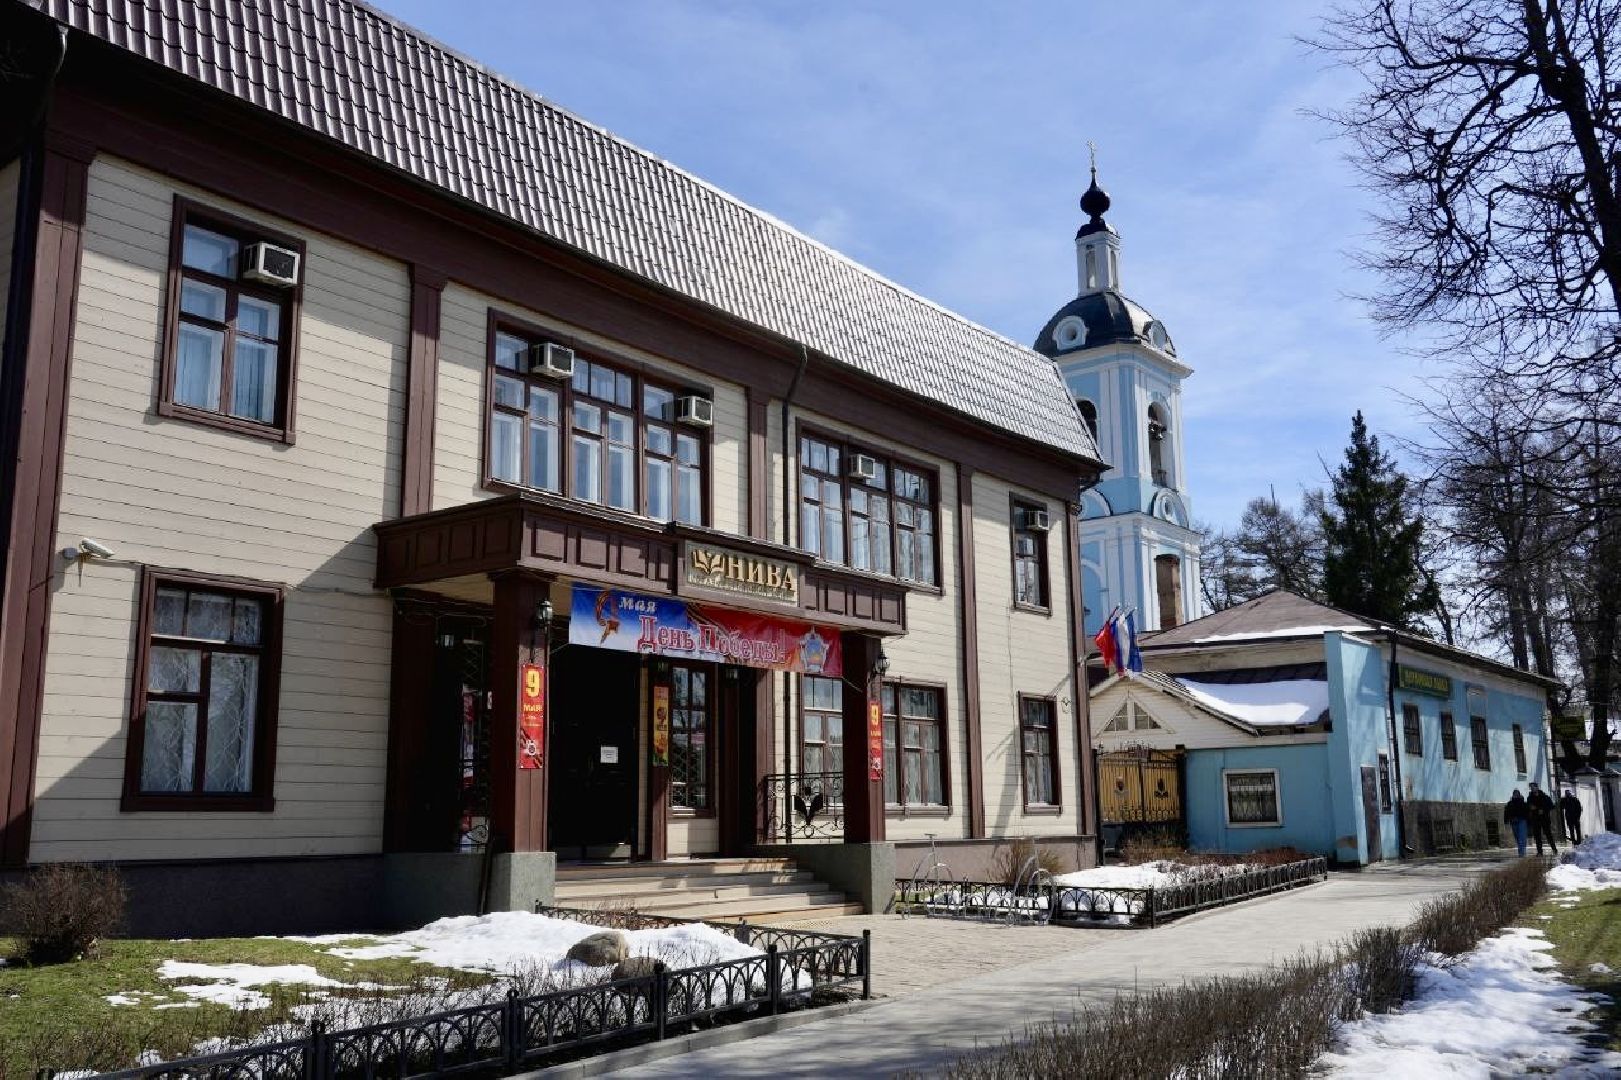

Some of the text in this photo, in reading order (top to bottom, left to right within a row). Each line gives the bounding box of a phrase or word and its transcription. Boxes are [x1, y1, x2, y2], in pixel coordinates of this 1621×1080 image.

[725, 555, 796, 592] НИВА
[637, 615, 696, 654] День
[525, 670, 540, 697] 9
[871, 705, 879, 725] 9
